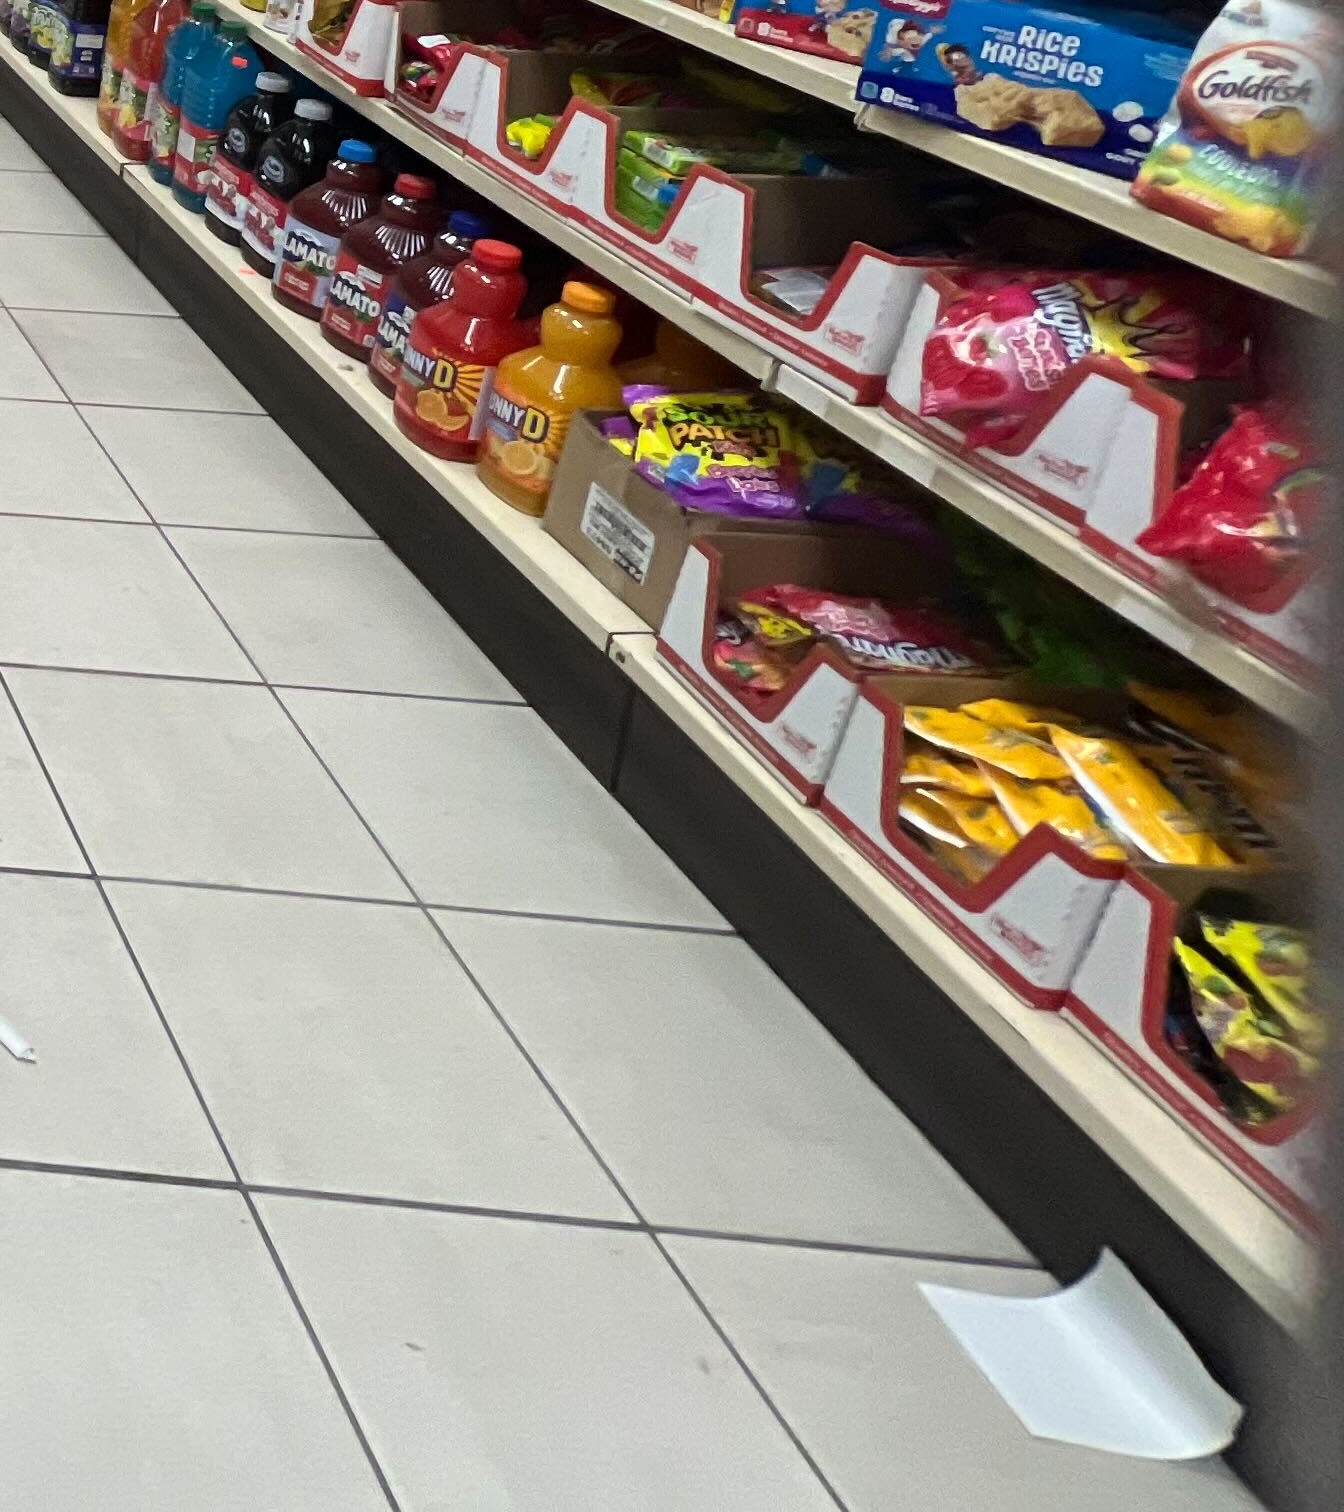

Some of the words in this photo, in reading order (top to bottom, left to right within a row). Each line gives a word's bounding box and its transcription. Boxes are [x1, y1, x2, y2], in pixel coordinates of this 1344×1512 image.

[879, 86, 895, 104] 8
[1198, 69, 1313, 103] Goldfish
[285, 236, 336, 270] LAMATO
[329, 279, 381, 318] LAMATO
[669, 422, 782, 449] PATCH
